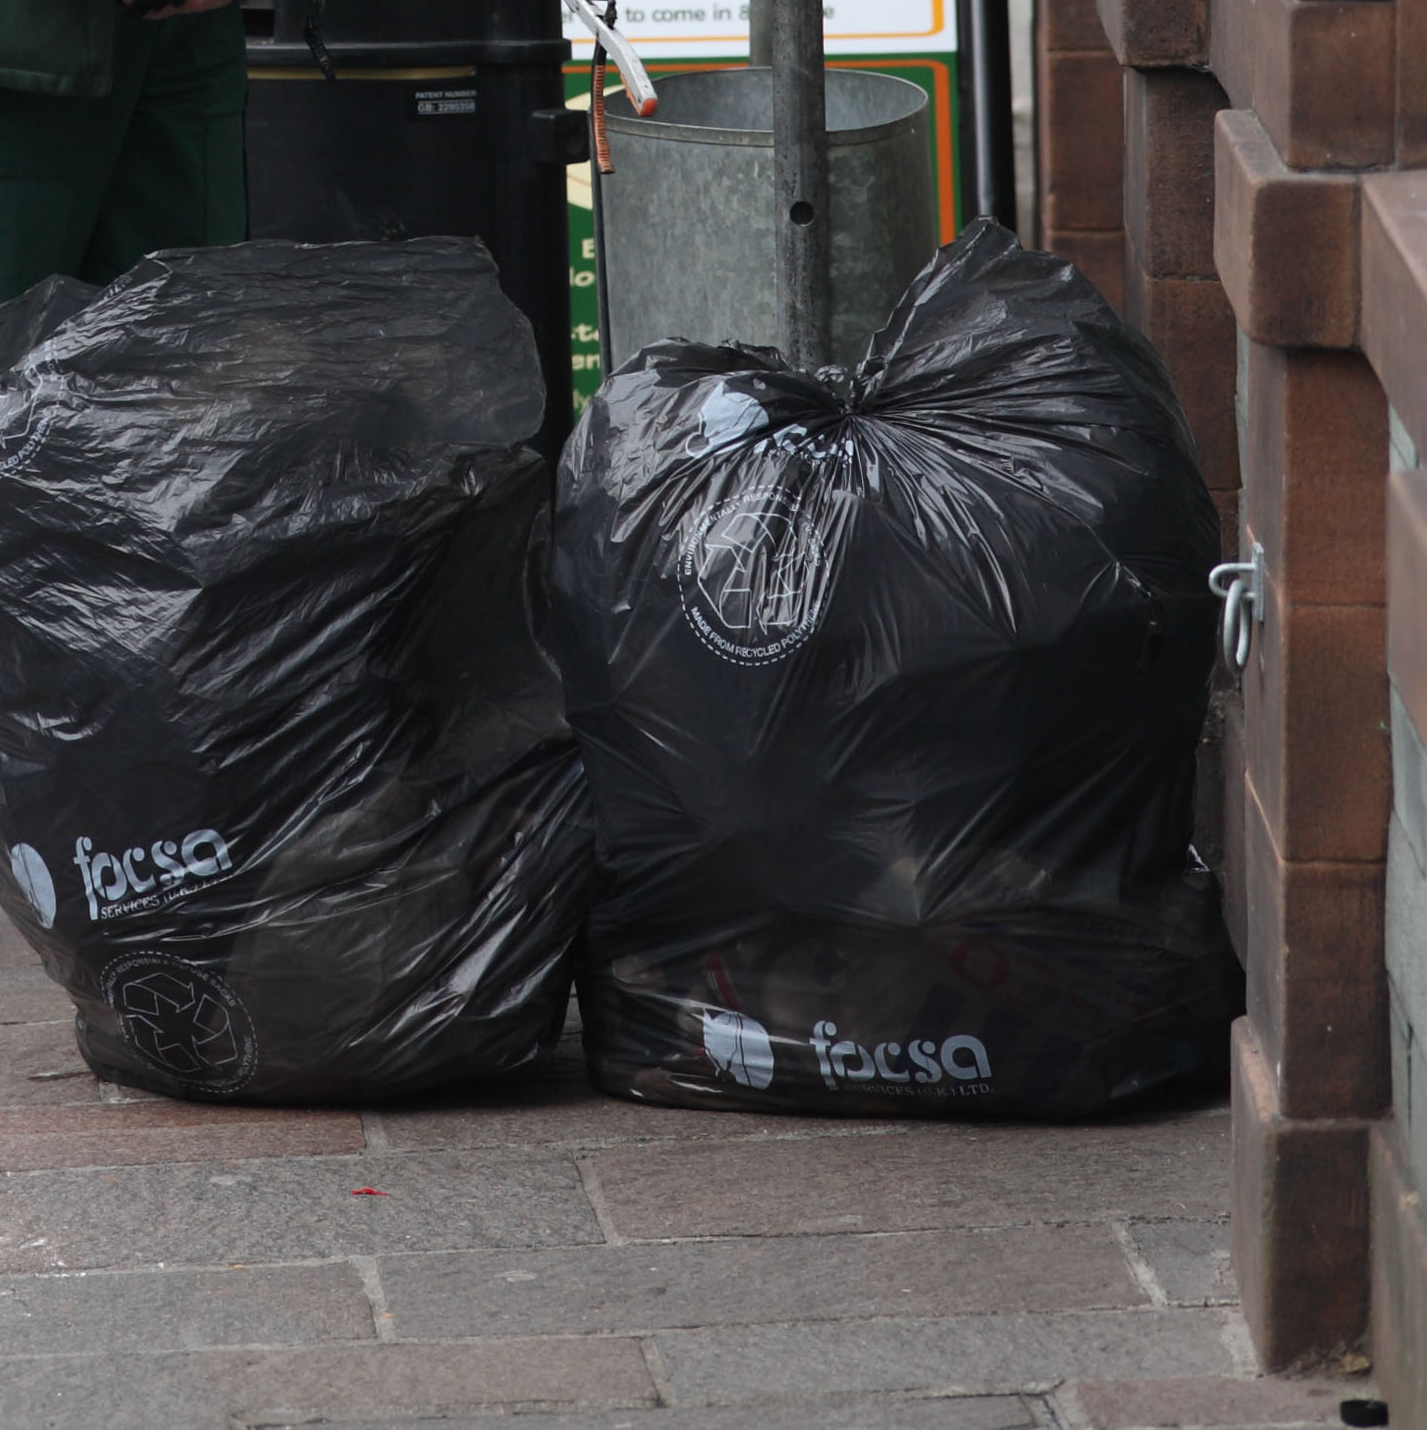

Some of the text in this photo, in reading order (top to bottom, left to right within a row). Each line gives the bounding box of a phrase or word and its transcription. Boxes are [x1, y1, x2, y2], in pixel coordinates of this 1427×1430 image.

[625, 6, 645, 23] to
[652, 8, 706, 23] come
[713, 4, 732, 21] in
[690, 605, 710, 636] MADE
[708, 632, 735, 654] FROM
[735, 642, 782, 658] RECYCLED
[73, 828, 233, 921] focsa
[809, 1020, 992, 1091] focsa
